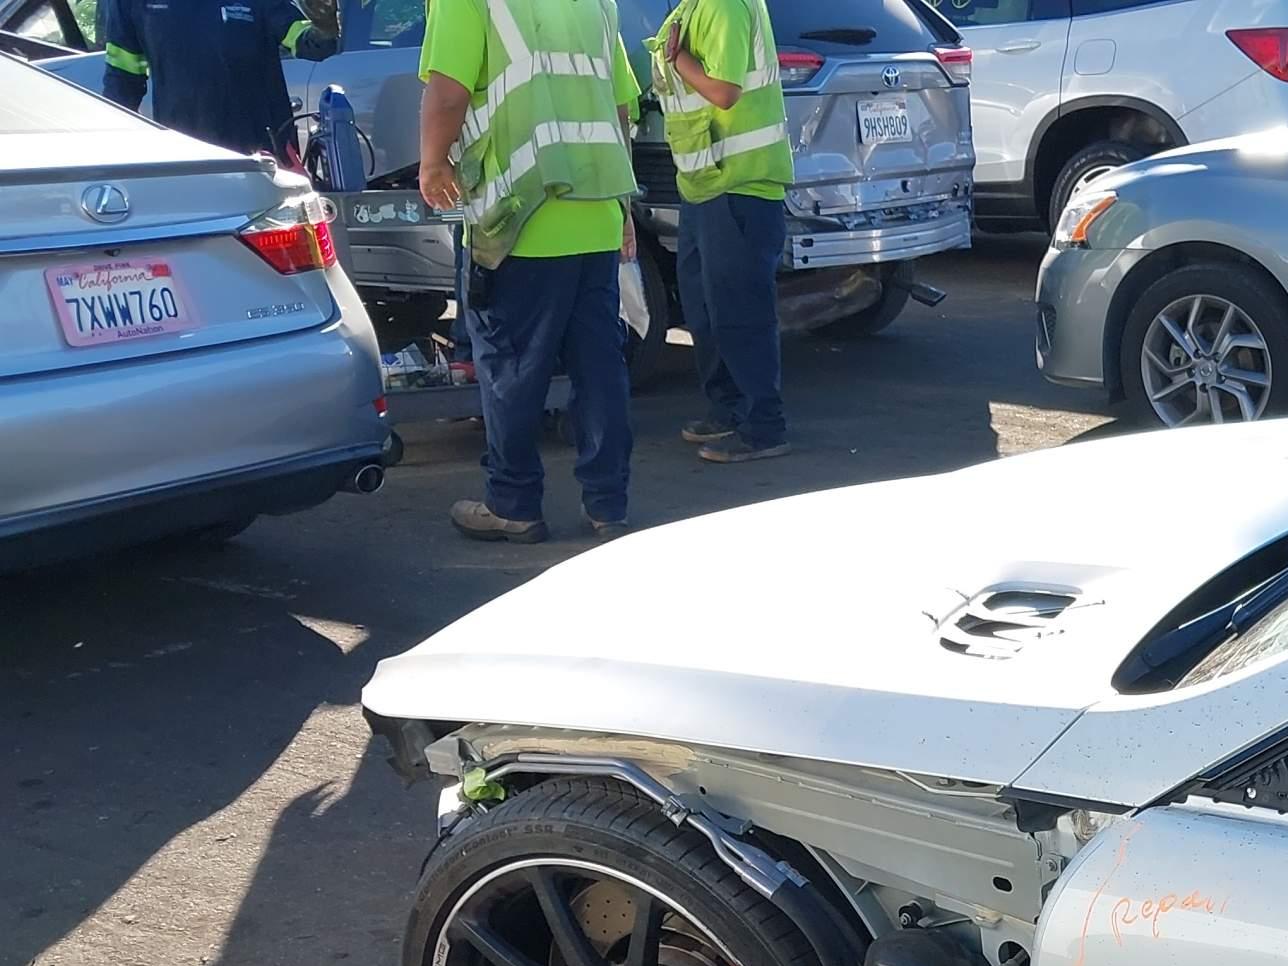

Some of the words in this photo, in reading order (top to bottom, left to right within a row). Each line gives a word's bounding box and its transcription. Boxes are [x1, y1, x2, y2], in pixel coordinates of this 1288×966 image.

[863, 115, 908, 139] 9HSH809
[78, 271, 153, 292] California
[65, 287, 178, 332] 7XWW760
[117, 325, 164, 339] AutoNation
